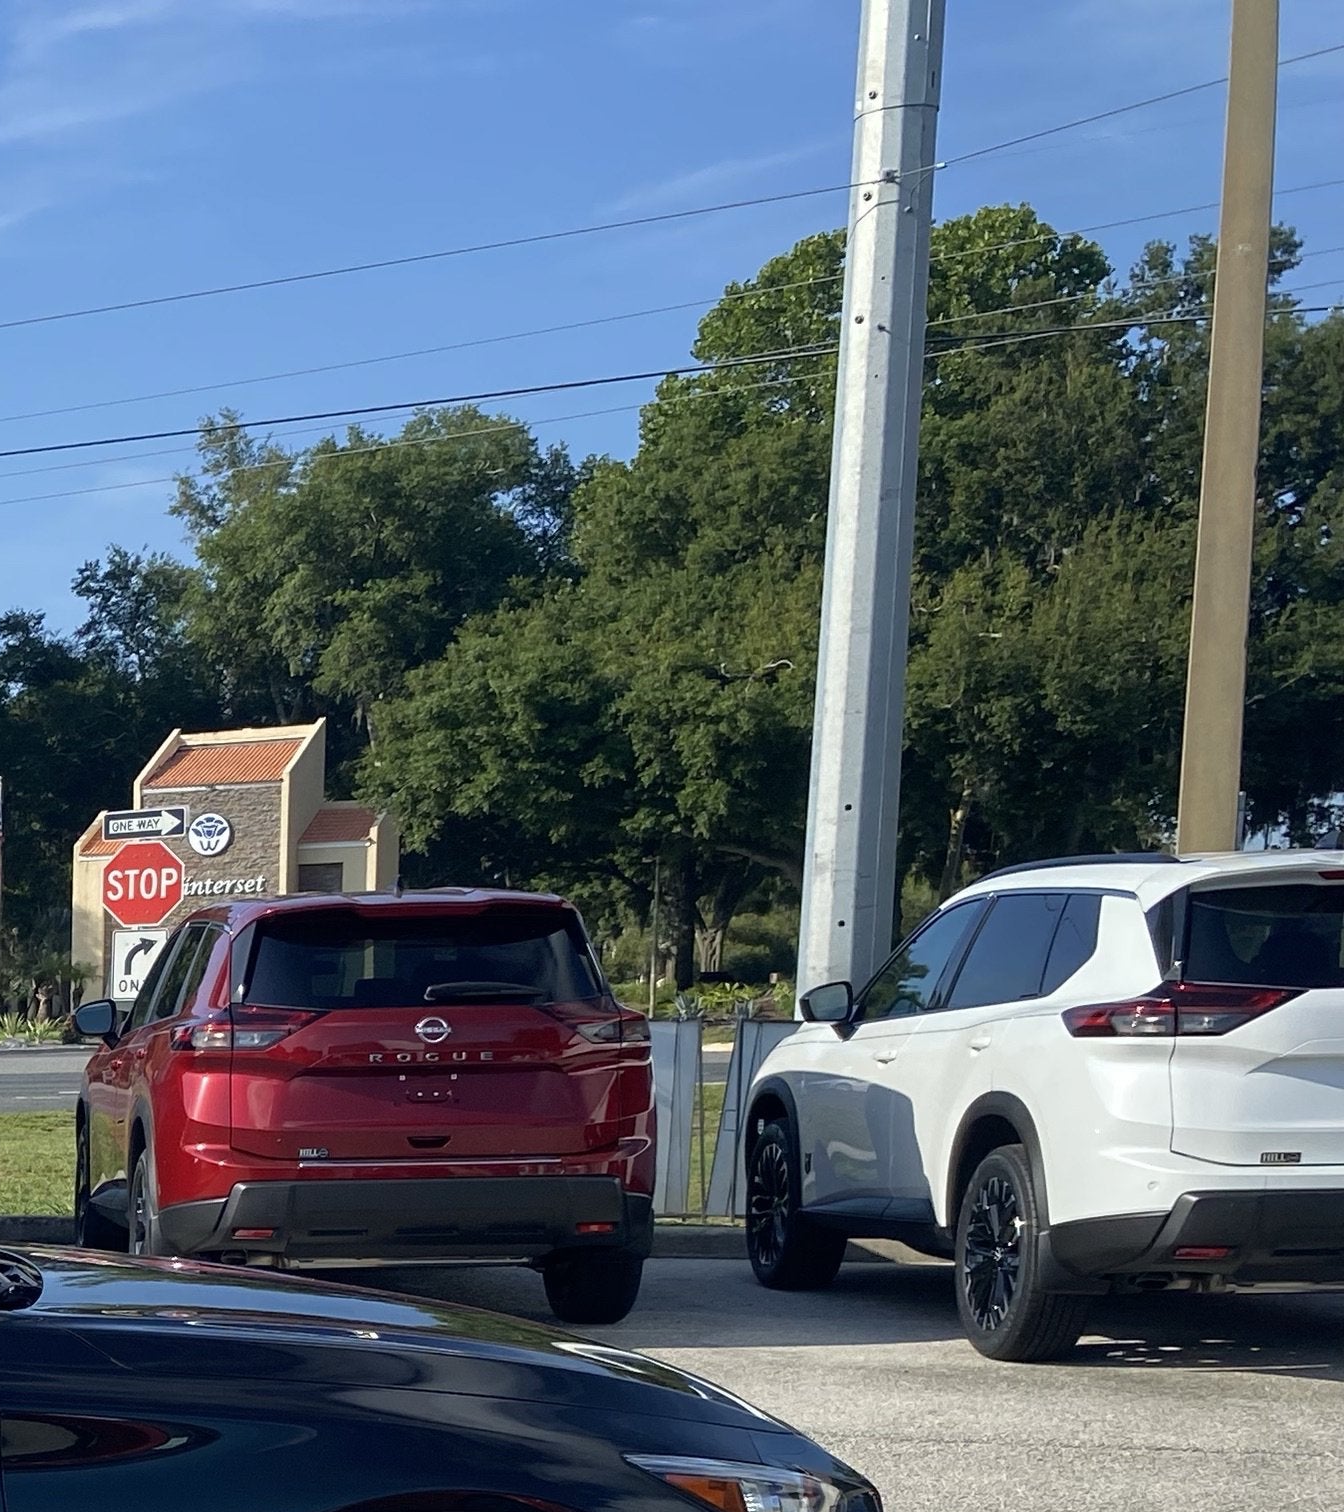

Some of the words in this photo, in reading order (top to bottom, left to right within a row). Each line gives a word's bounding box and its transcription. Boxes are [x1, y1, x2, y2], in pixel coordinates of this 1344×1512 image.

[111, 820, 134, 832] ONE
[136, 818, 161, 829] WAY
[106, 866, 179, 901] STOP
[183, 874, 266, 896] interset
[369, 1051, 494, 1063] ROGUE
